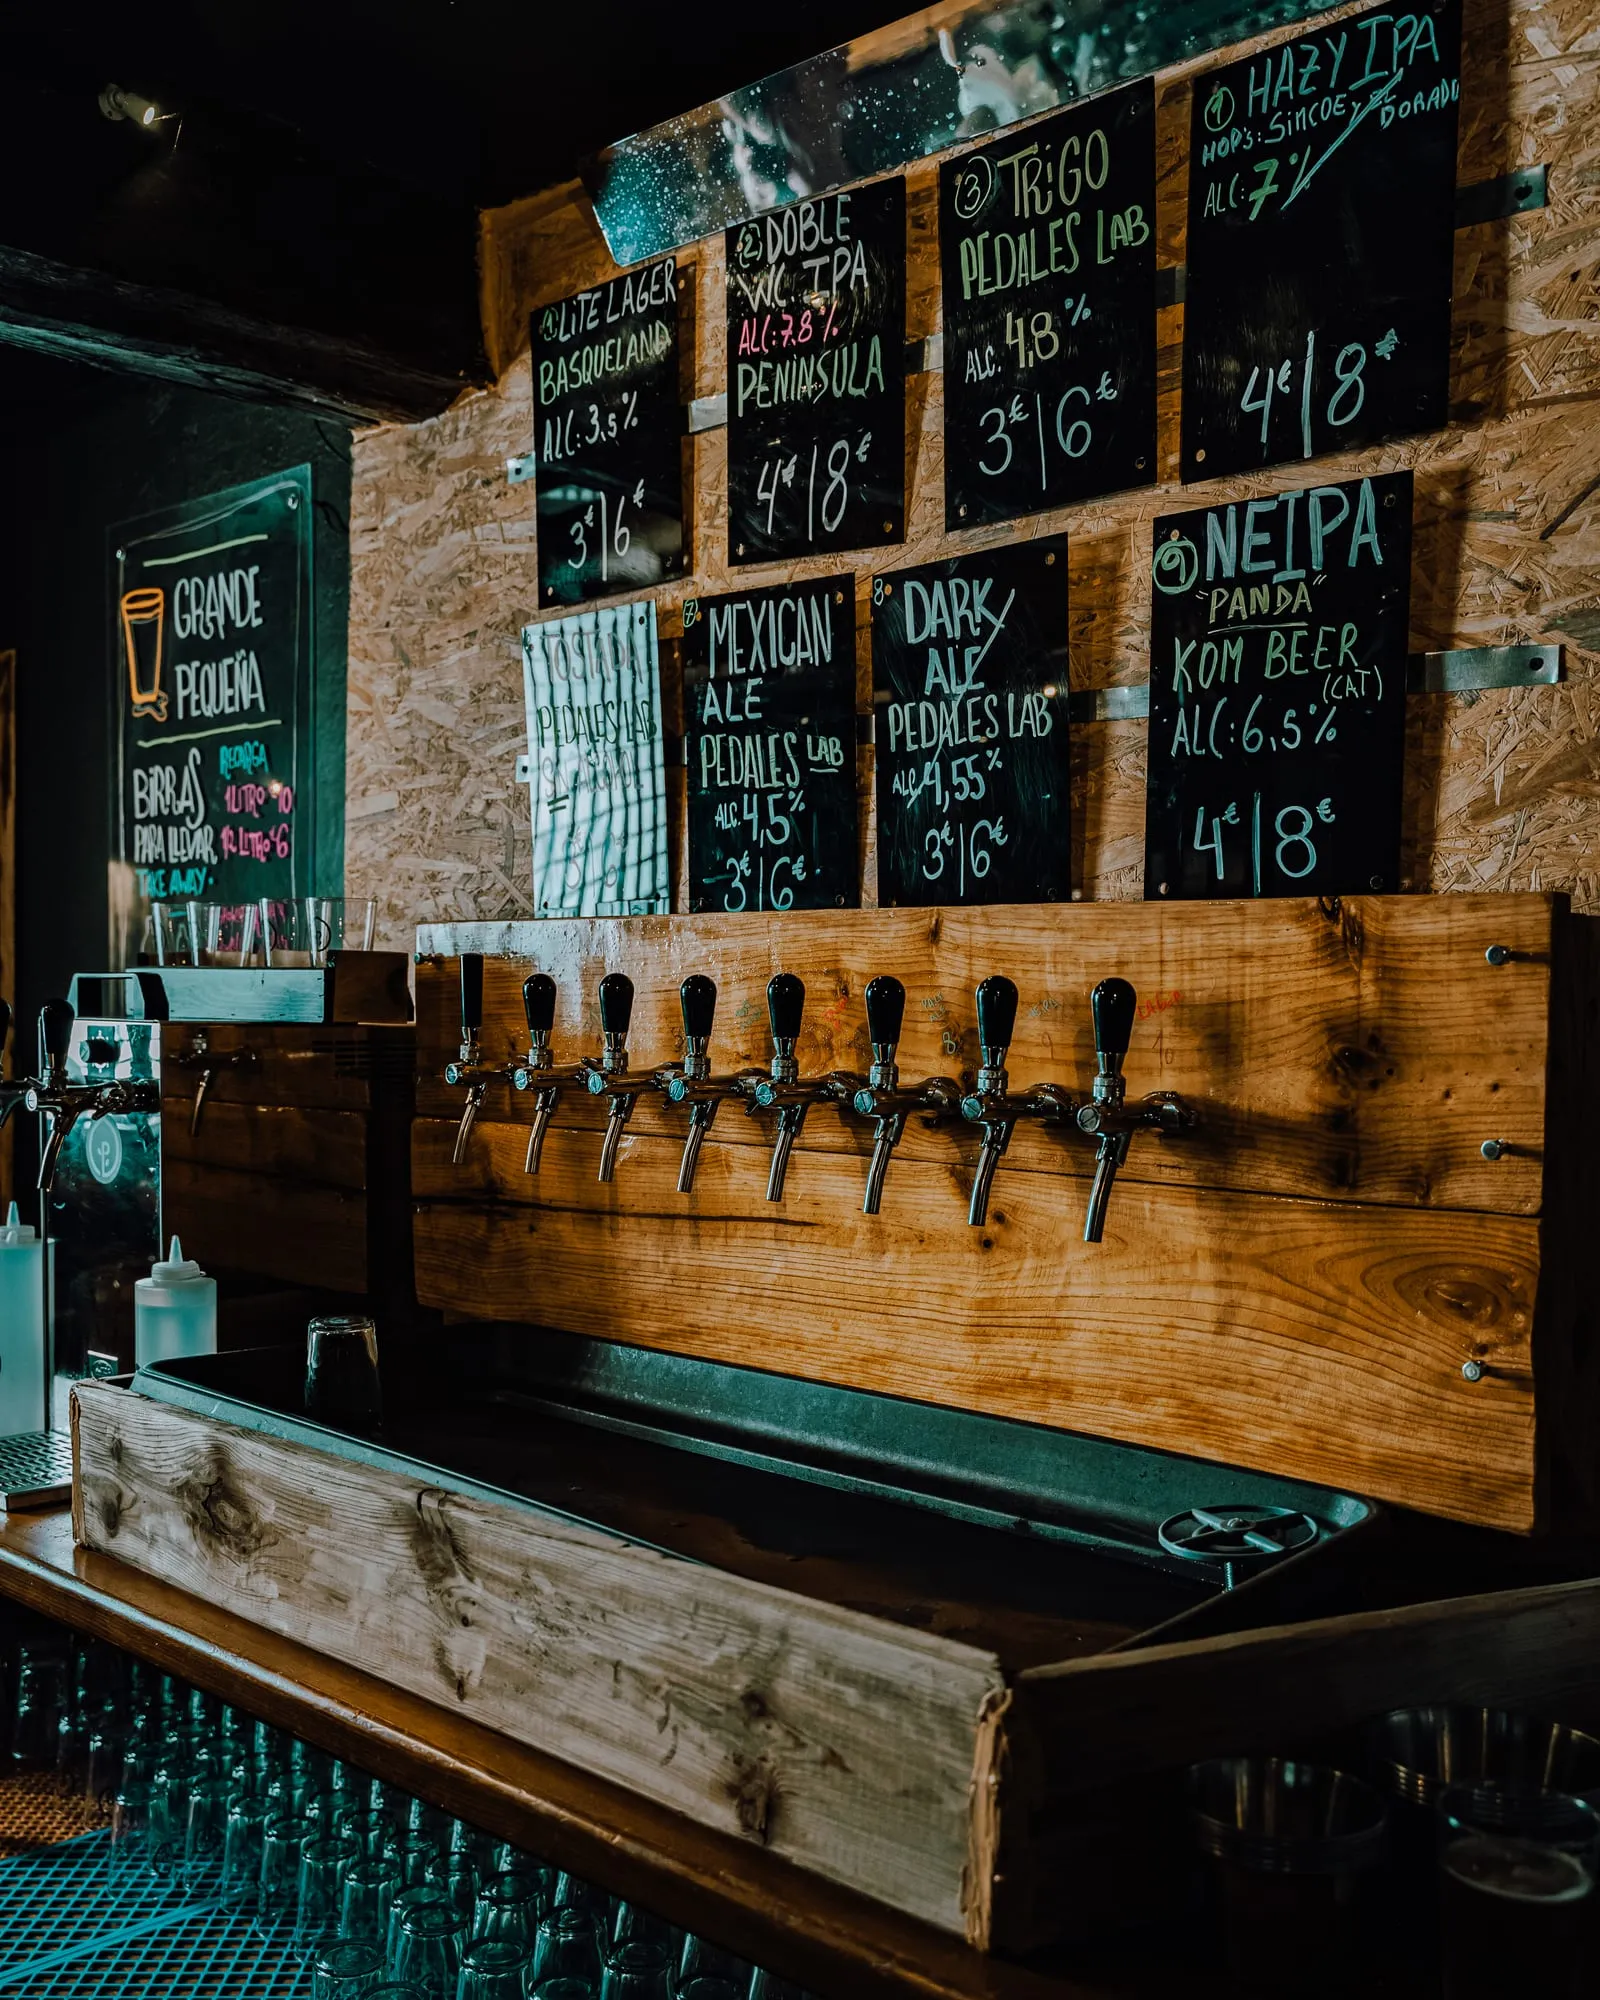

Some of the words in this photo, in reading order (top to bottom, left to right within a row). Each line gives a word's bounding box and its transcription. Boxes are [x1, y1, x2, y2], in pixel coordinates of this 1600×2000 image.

[1248, 32, 1347, 117] HAZY
[1349, 15, 1439, 91] IPA
[766, 194, 851, 264] DOBLE
[960, 211, 1081, 299] PEDALES
[1097, 205, 1150, 264] LAB
[606, 258, 676, 324] LAGER
[802, 240, 869, 303] IPA
[539, 319, 672, 405] BASQUELAND
[1205, 478, 1384, 584] NEIPA
[173, 565, 263, 640] GRANDE
[709, 593, 832, 679] MEXICAN
[904, 577, 1005, 645] DARK
[174, 648, 266, 720] PEQUEÑA
[924, 646, 985, 696] ALE
[1172, 637, 1244, 693] KOM
[1264, 622, 1359, 680] BEER
[1323, 665, 1382, 704] (CAT)
[537, 700, 619, 749] PEDALES
[624, 700, 657, 741] LAB
[702, 677, 763, 725] ALE
[888, 694, 999, 753] PEDALES
[1007, 692, 1053, 738] LAB
[701, 732, 801, 788] PEDALES
[807, 734, 844, 766] LAB
[134, 824, 166, 864] PARA
[168, 824, 218, 865] LLEVAR
[135, 867, 168, 898] TAKE
[169, 866, 208, 897] AWAY
